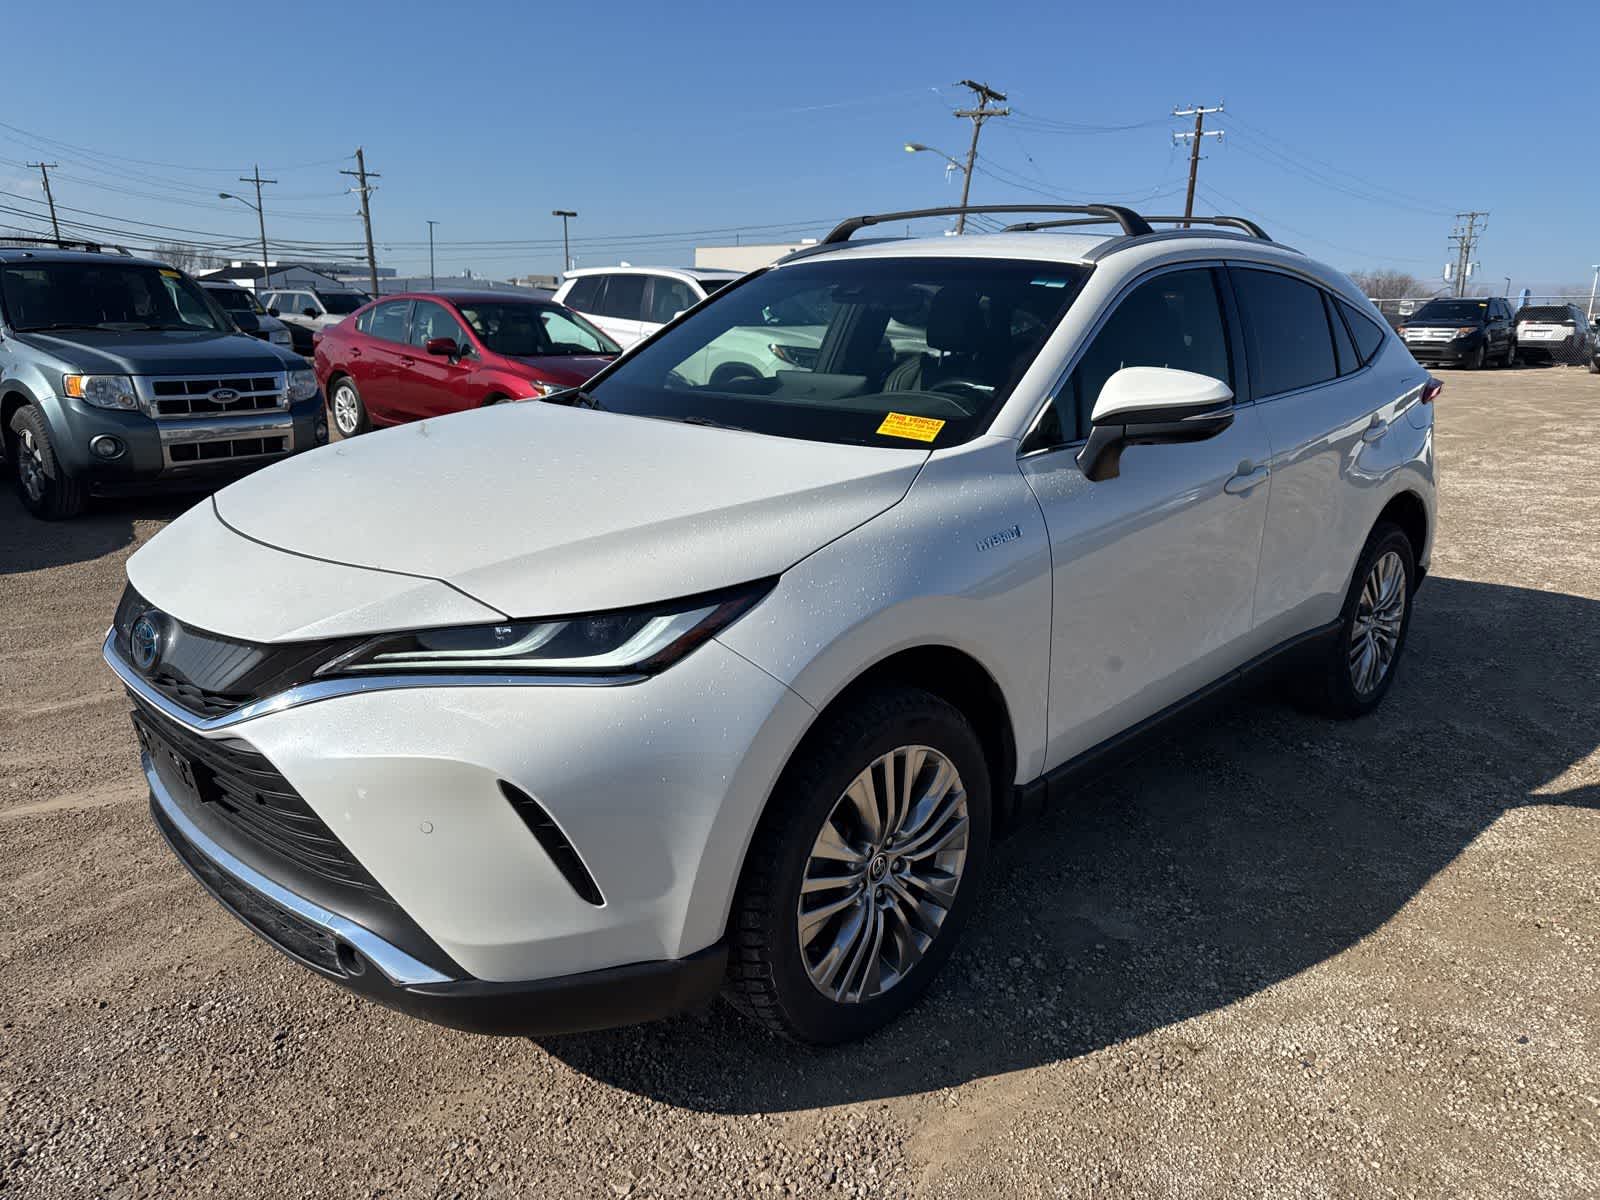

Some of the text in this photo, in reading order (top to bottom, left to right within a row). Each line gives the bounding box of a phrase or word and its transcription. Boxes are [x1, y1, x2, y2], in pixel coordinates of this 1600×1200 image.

[889, 413, 941, 426] THIS VEHICLE
[975, 525, 1021, 552] HYBRID
